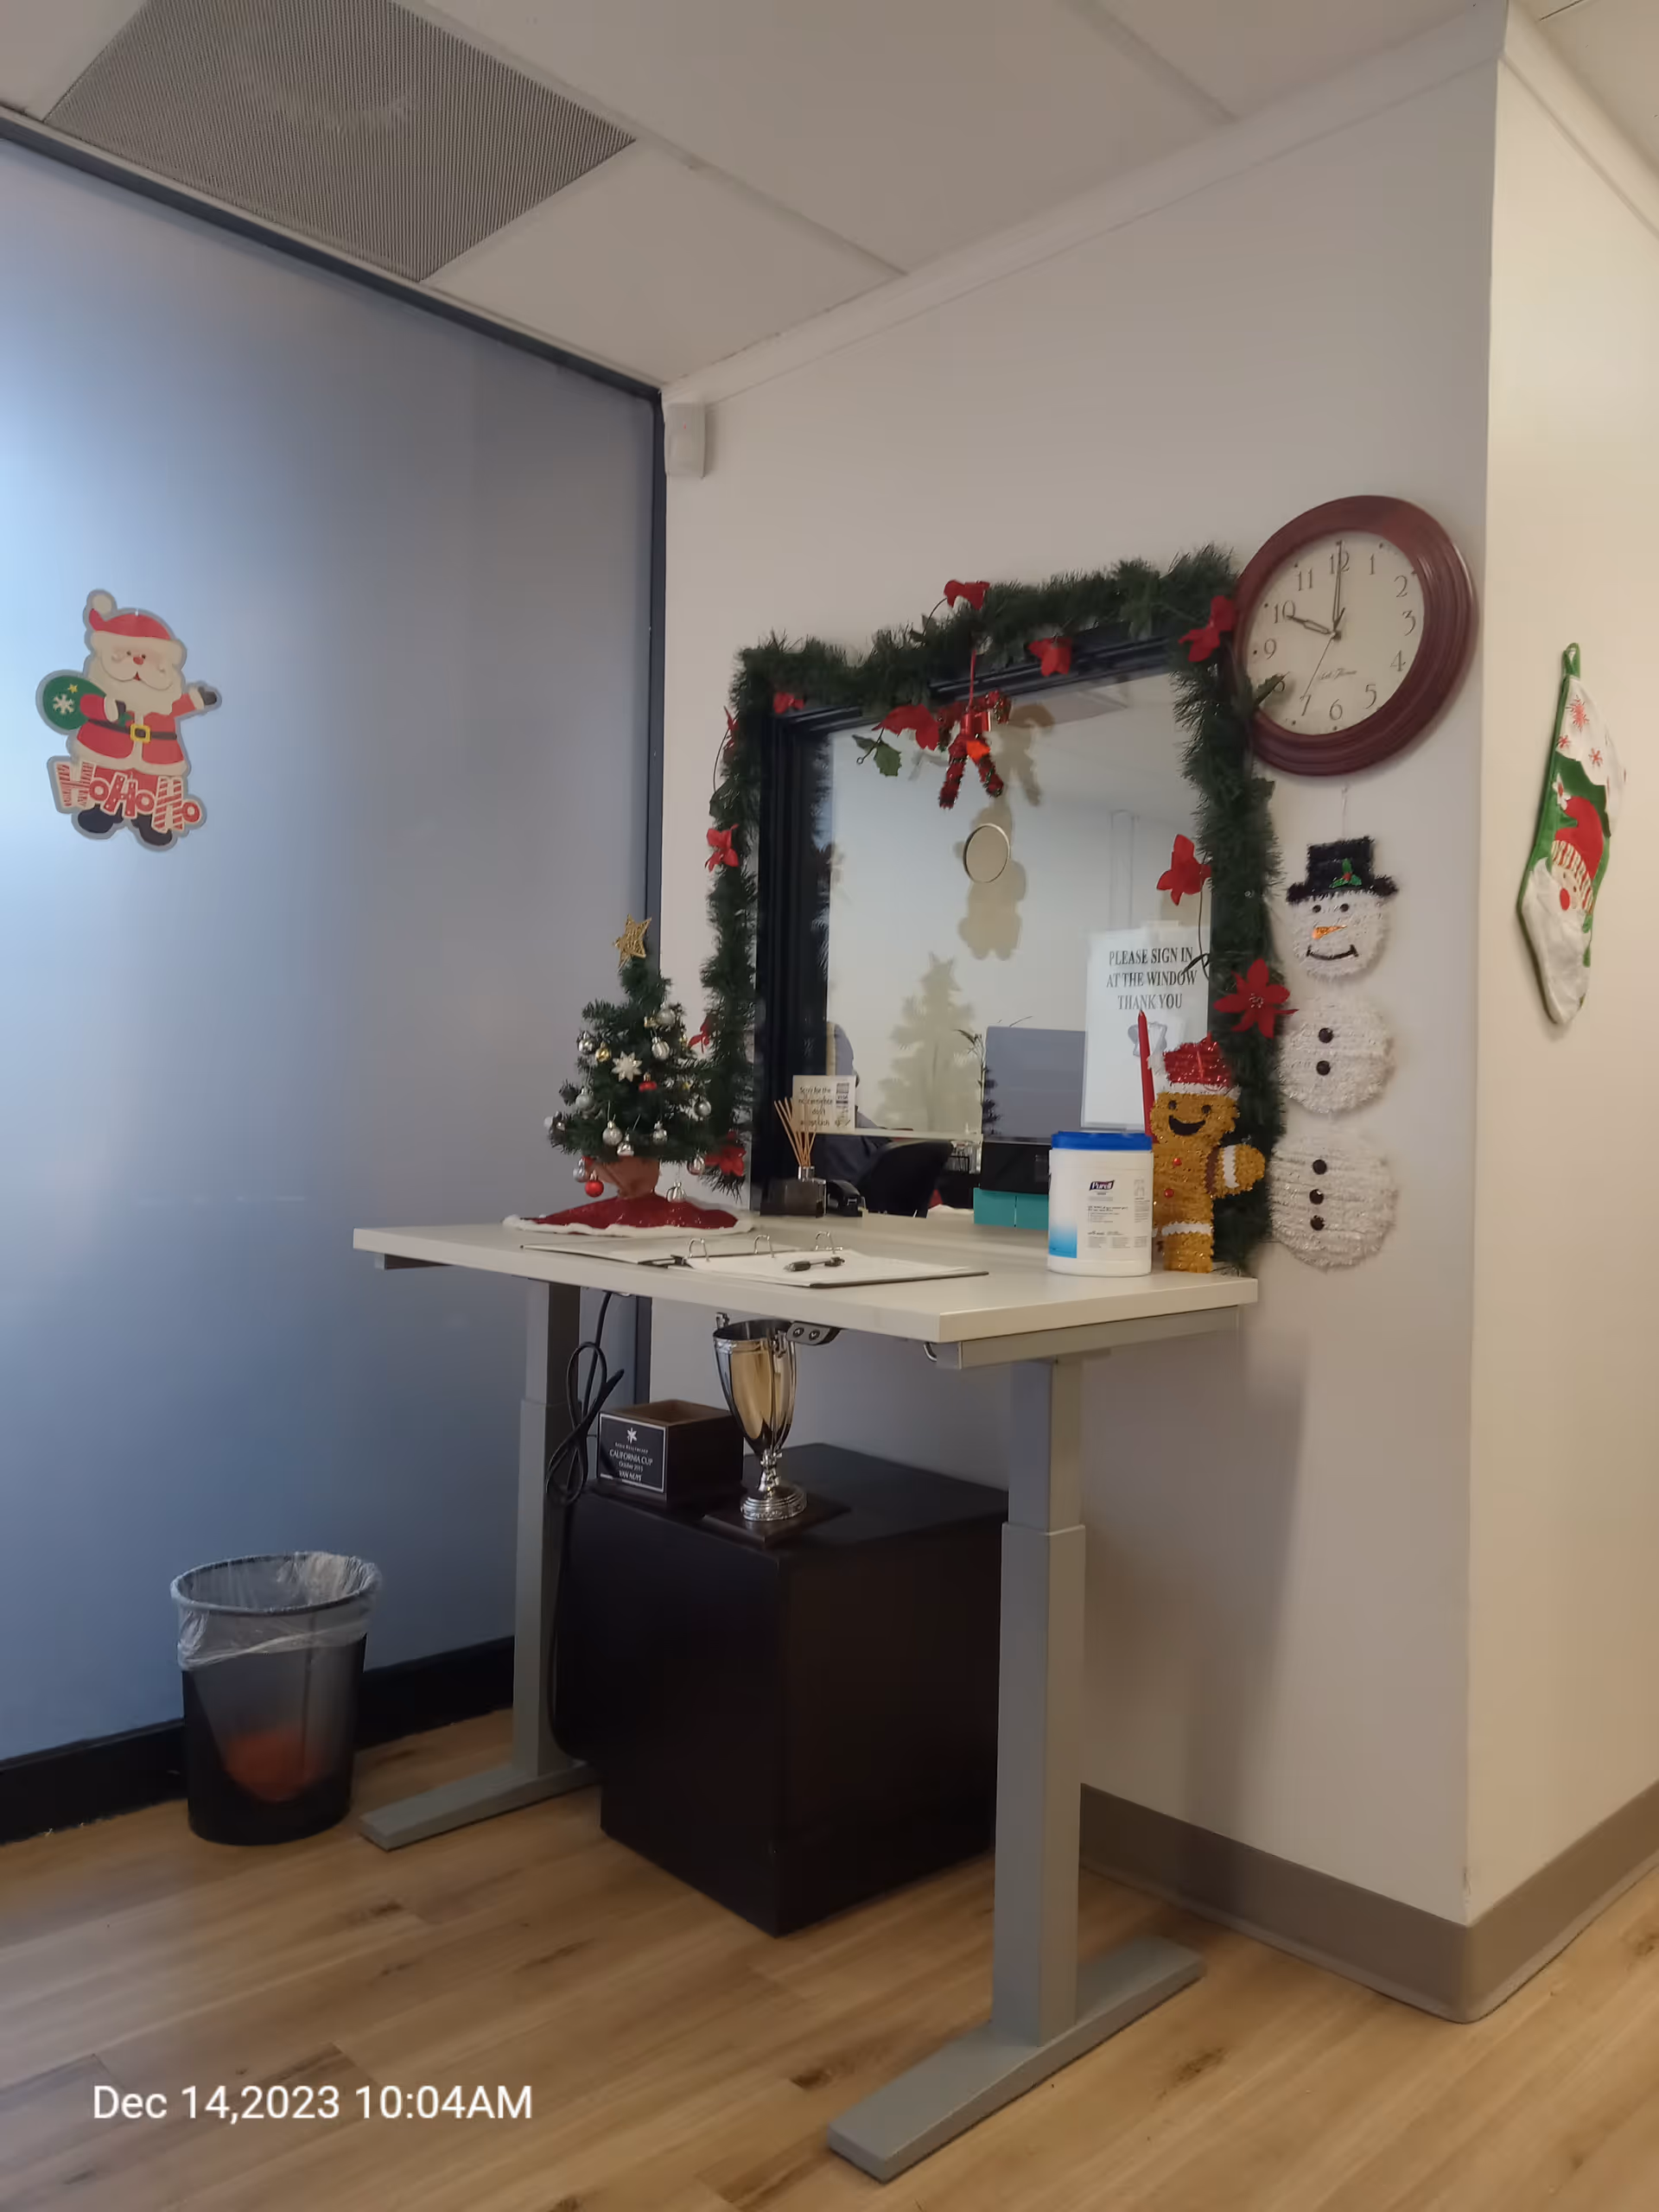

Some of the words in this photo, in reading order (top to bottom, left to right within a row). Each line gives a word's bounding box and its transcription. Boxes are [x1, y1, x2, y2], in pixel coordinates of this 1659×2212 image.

[1329, 550, 1350, 575] 12
[1369, 553, 1376, 575] 1
[1298, 567, 1313, 592] 11
[1394, 575, 1408, 598] 2
[1273, 600, 1295, 624] 10
[1402, 609, 1416, 636] 3
[1264, 638, 1276, 659] 9
[1390, 650, 1406, 672] 4
[1300, 694, 1312, 716] 7
[1363, 683, 1376, 709] 5
[1329, 699, 1343, 721] 6
[1109, 949, 1148, 966] PLEASE
[1151, 947, 1178, 964] SIGN
[1180, 946, 1192, 963] IN
[1106, 973, 1121, 988] AT
[1122, 972, 1144, 987] THE
[1147, 969, 1198, 987] WINDOW
[1117, 994, 1156, 1010] THANK
[1159, 993, 1183, 1010] YOU
[609, 1448, 641, 1465] CALIFORNIA
[641, 1456, 653, 1466] CUP
